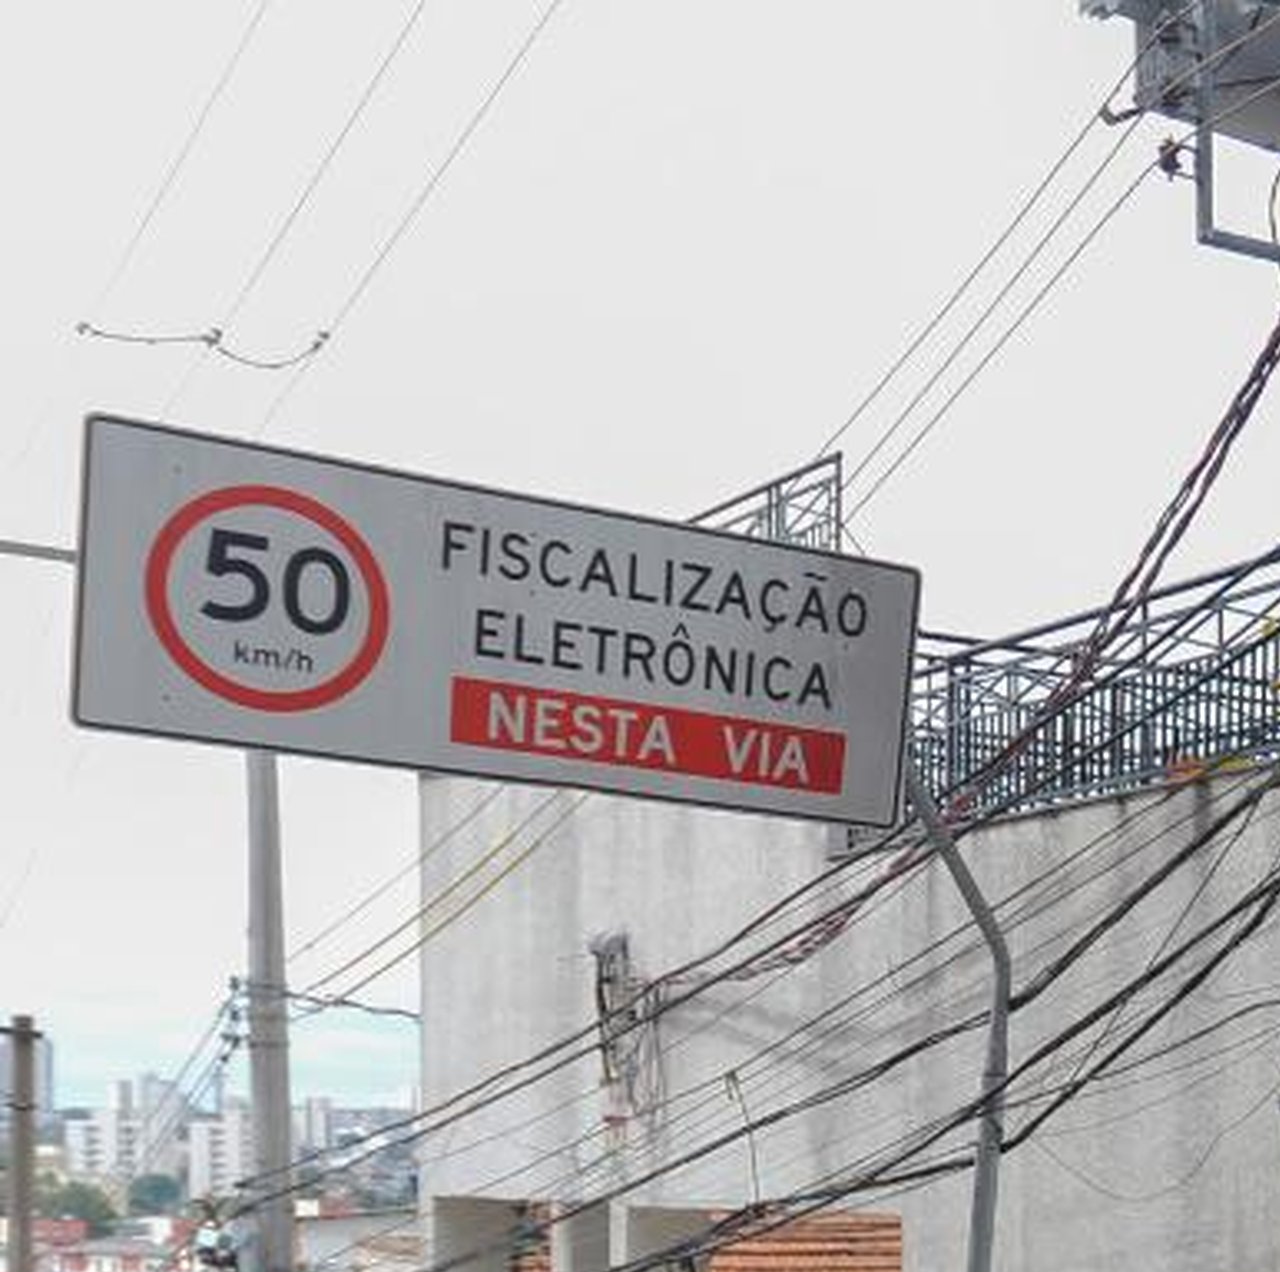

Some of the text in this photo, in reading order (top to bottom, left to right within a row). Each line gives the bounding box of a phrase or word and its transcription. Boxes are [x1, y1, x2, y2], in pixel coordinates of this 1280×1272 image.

[200, 528, 349, 634] 50
[442, 521, 867, 638] FISCALIZAÇÃO
[234, 641, 313, 673] km/h
[475, 609, 831, 709] ELETRÔNICA
[487, 691, 810, 783] NESTA VIA
